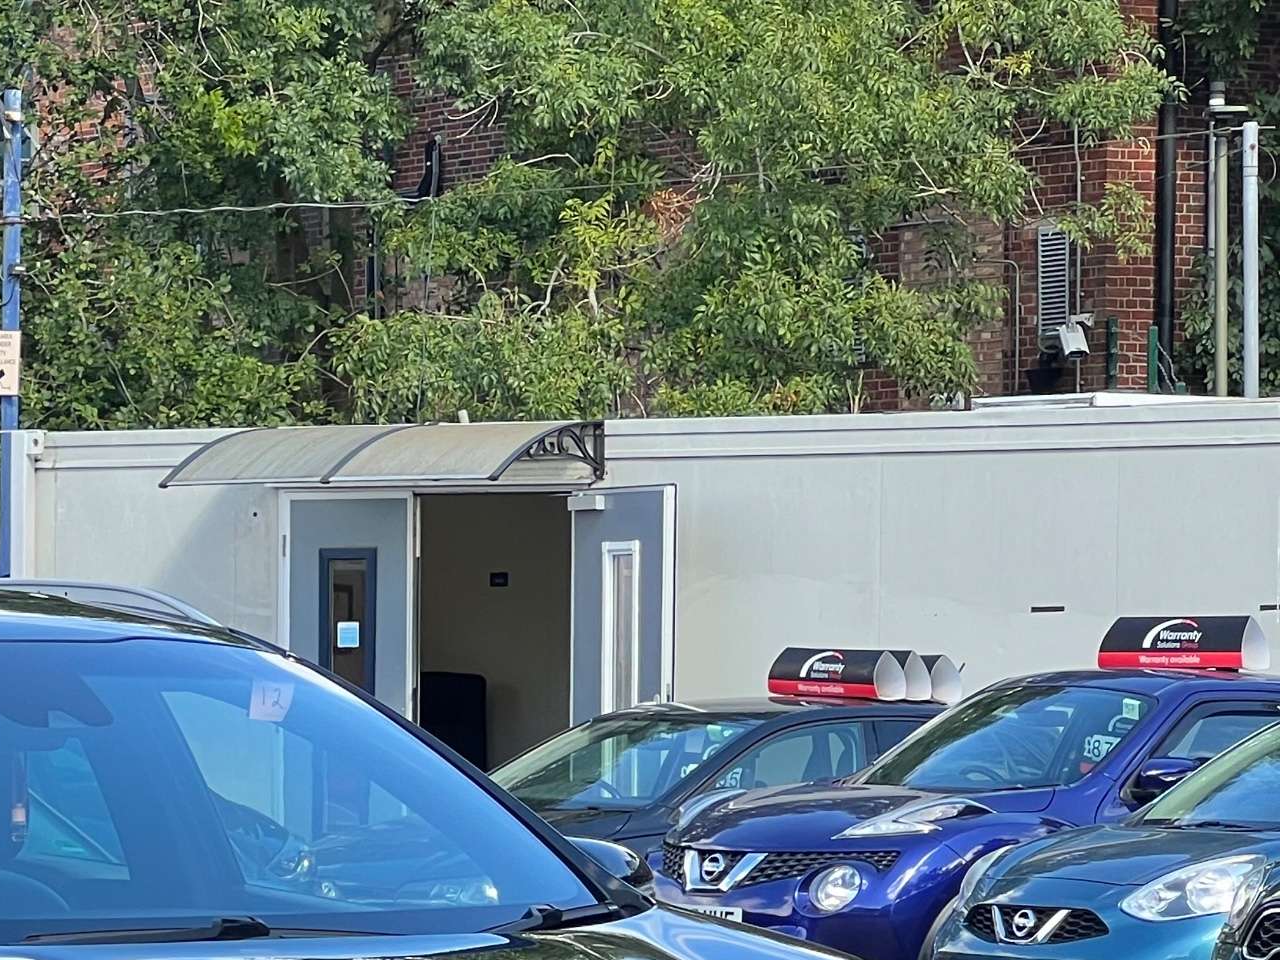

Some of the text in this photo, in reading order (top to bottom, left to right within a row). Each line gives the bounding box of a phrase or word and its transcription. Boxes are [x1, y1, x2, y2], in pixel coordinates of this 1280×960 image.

[1159, 630, 1202, 642] Warranty
[1156, 641, 1181, 649] Solutions
[1138, 655, 1201, 665] Warranty available
[812, 661, 845, 674] Warranty
[797, 683, 820, 693] Warranty
